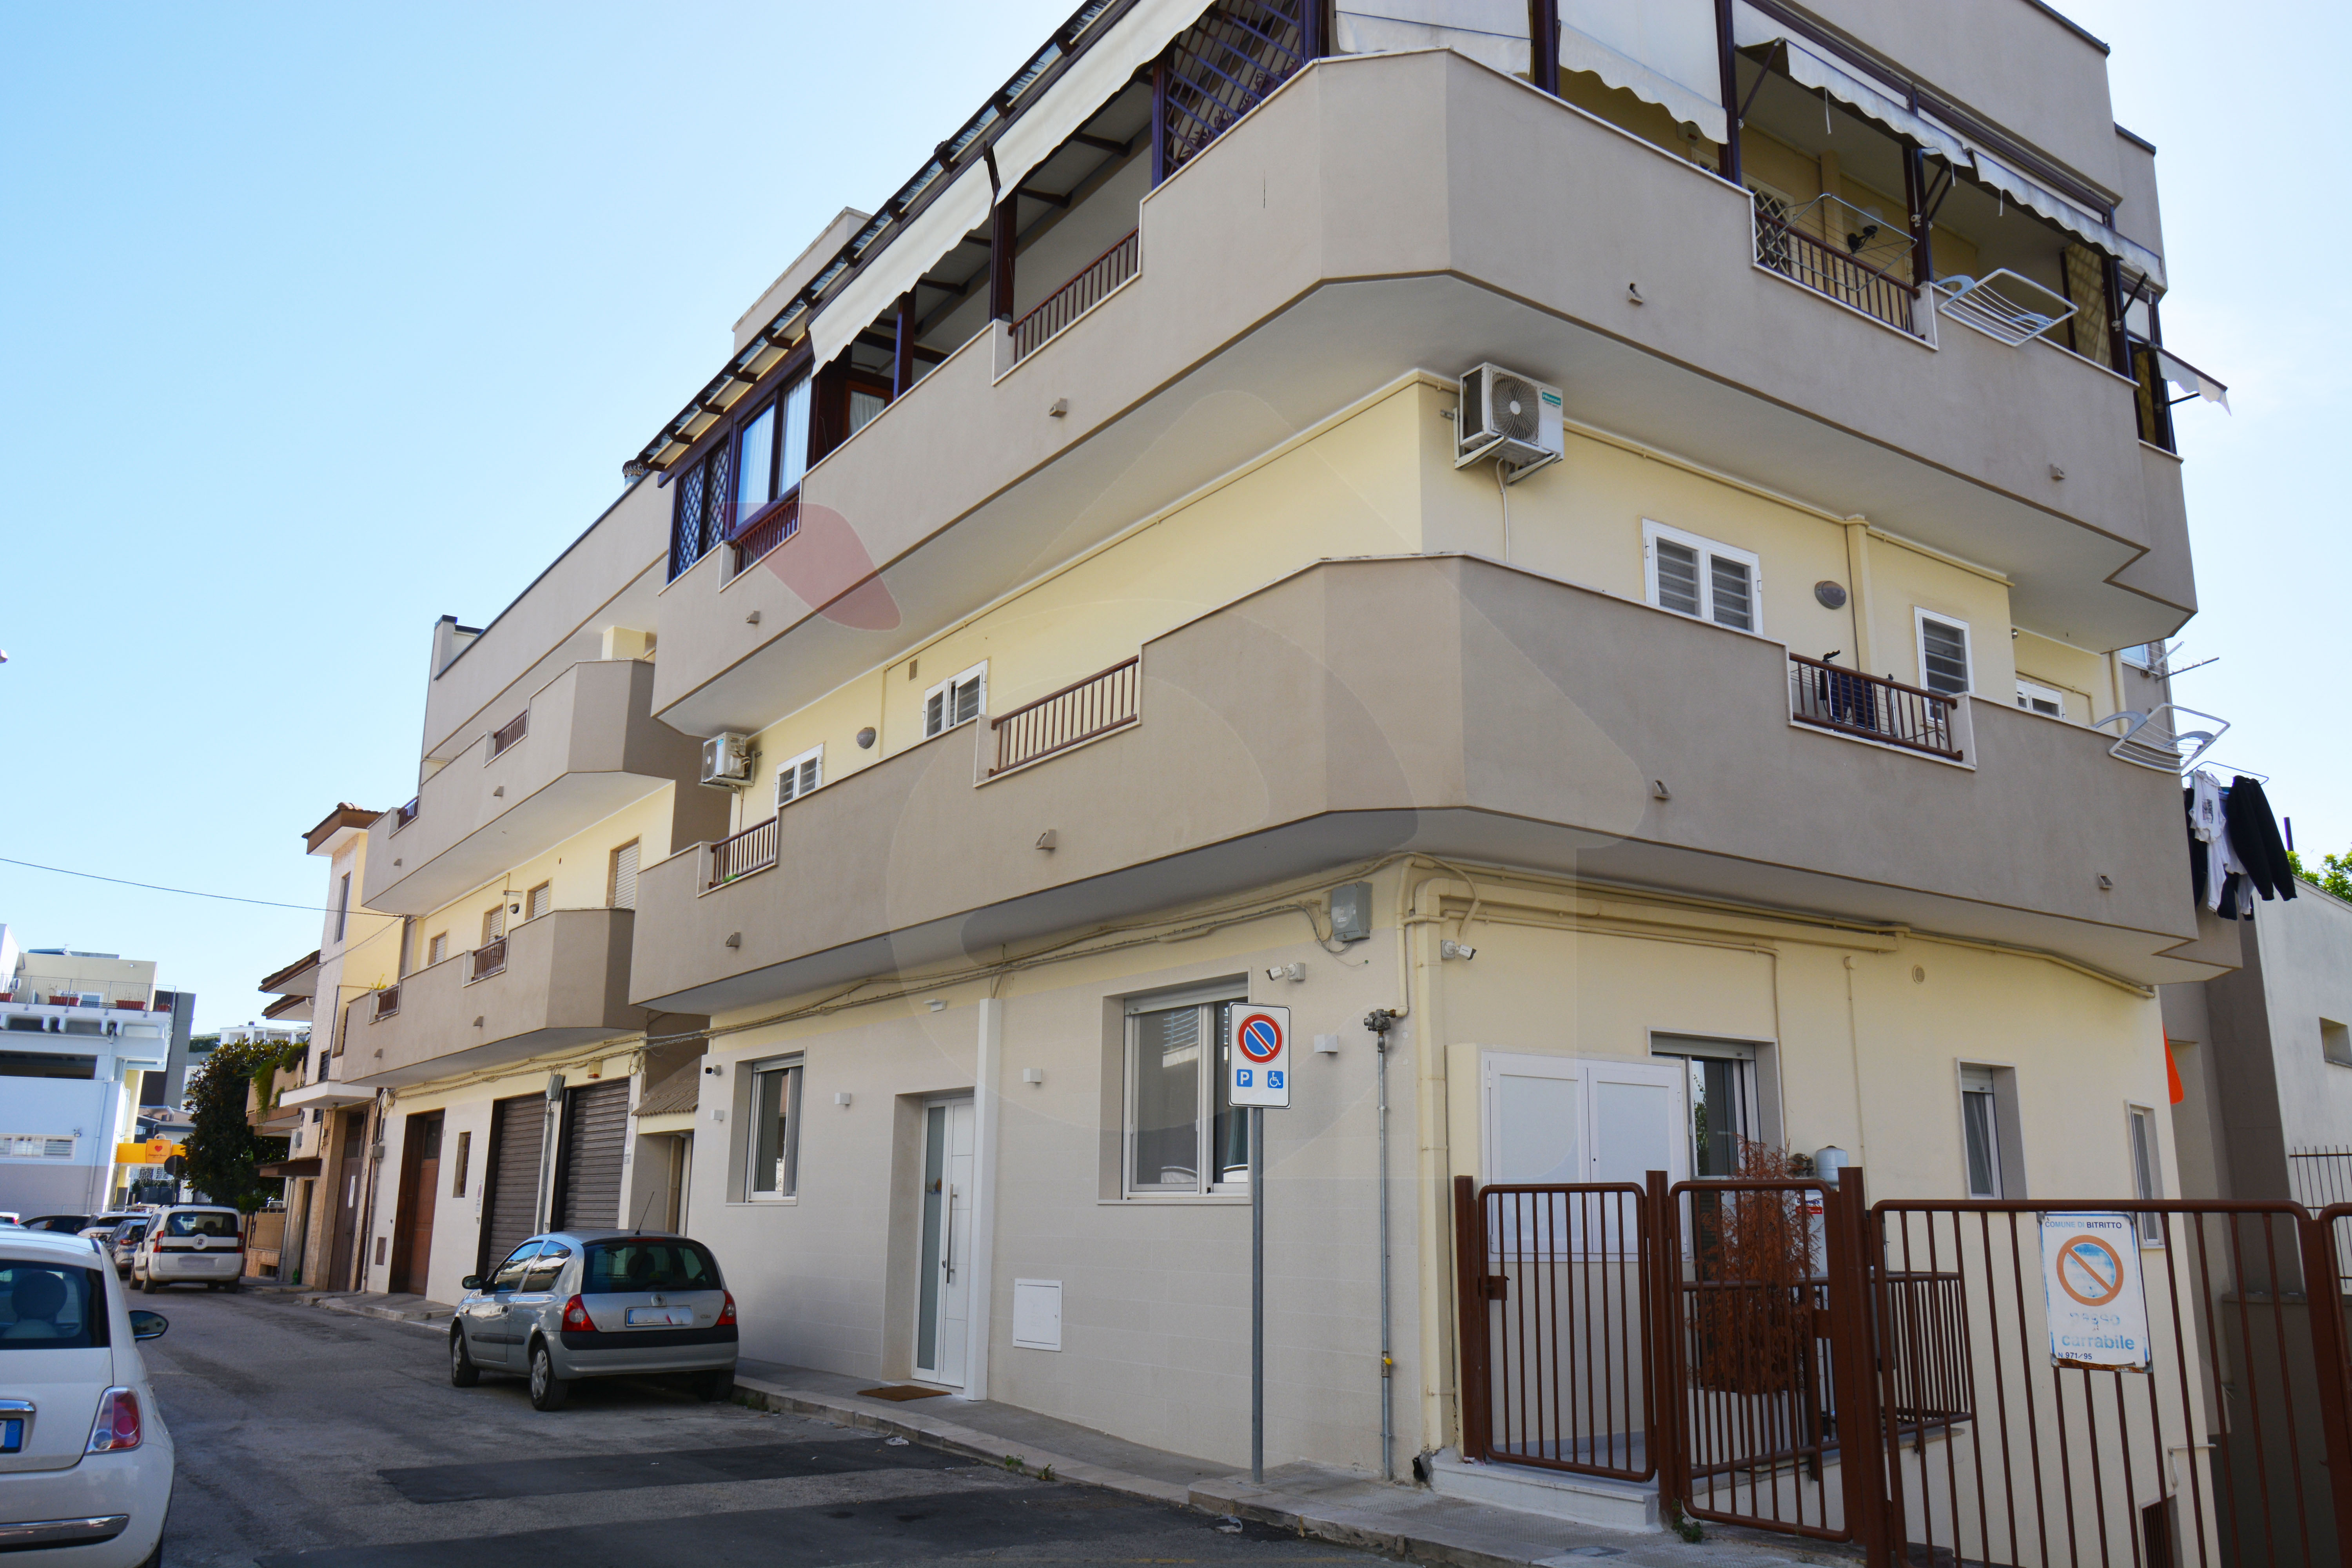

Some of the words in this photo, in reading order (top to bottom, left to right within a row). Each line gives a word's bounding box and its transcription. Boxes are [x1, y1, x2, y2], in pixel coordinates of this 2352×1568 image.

[1543, 393, 1561, 404] Hisense
[1240, 1071, 1250, 1085] P
[2062, 1334, 2135, 1350] carrabile
[2065, 1352, 2092, 1360] 971/95
